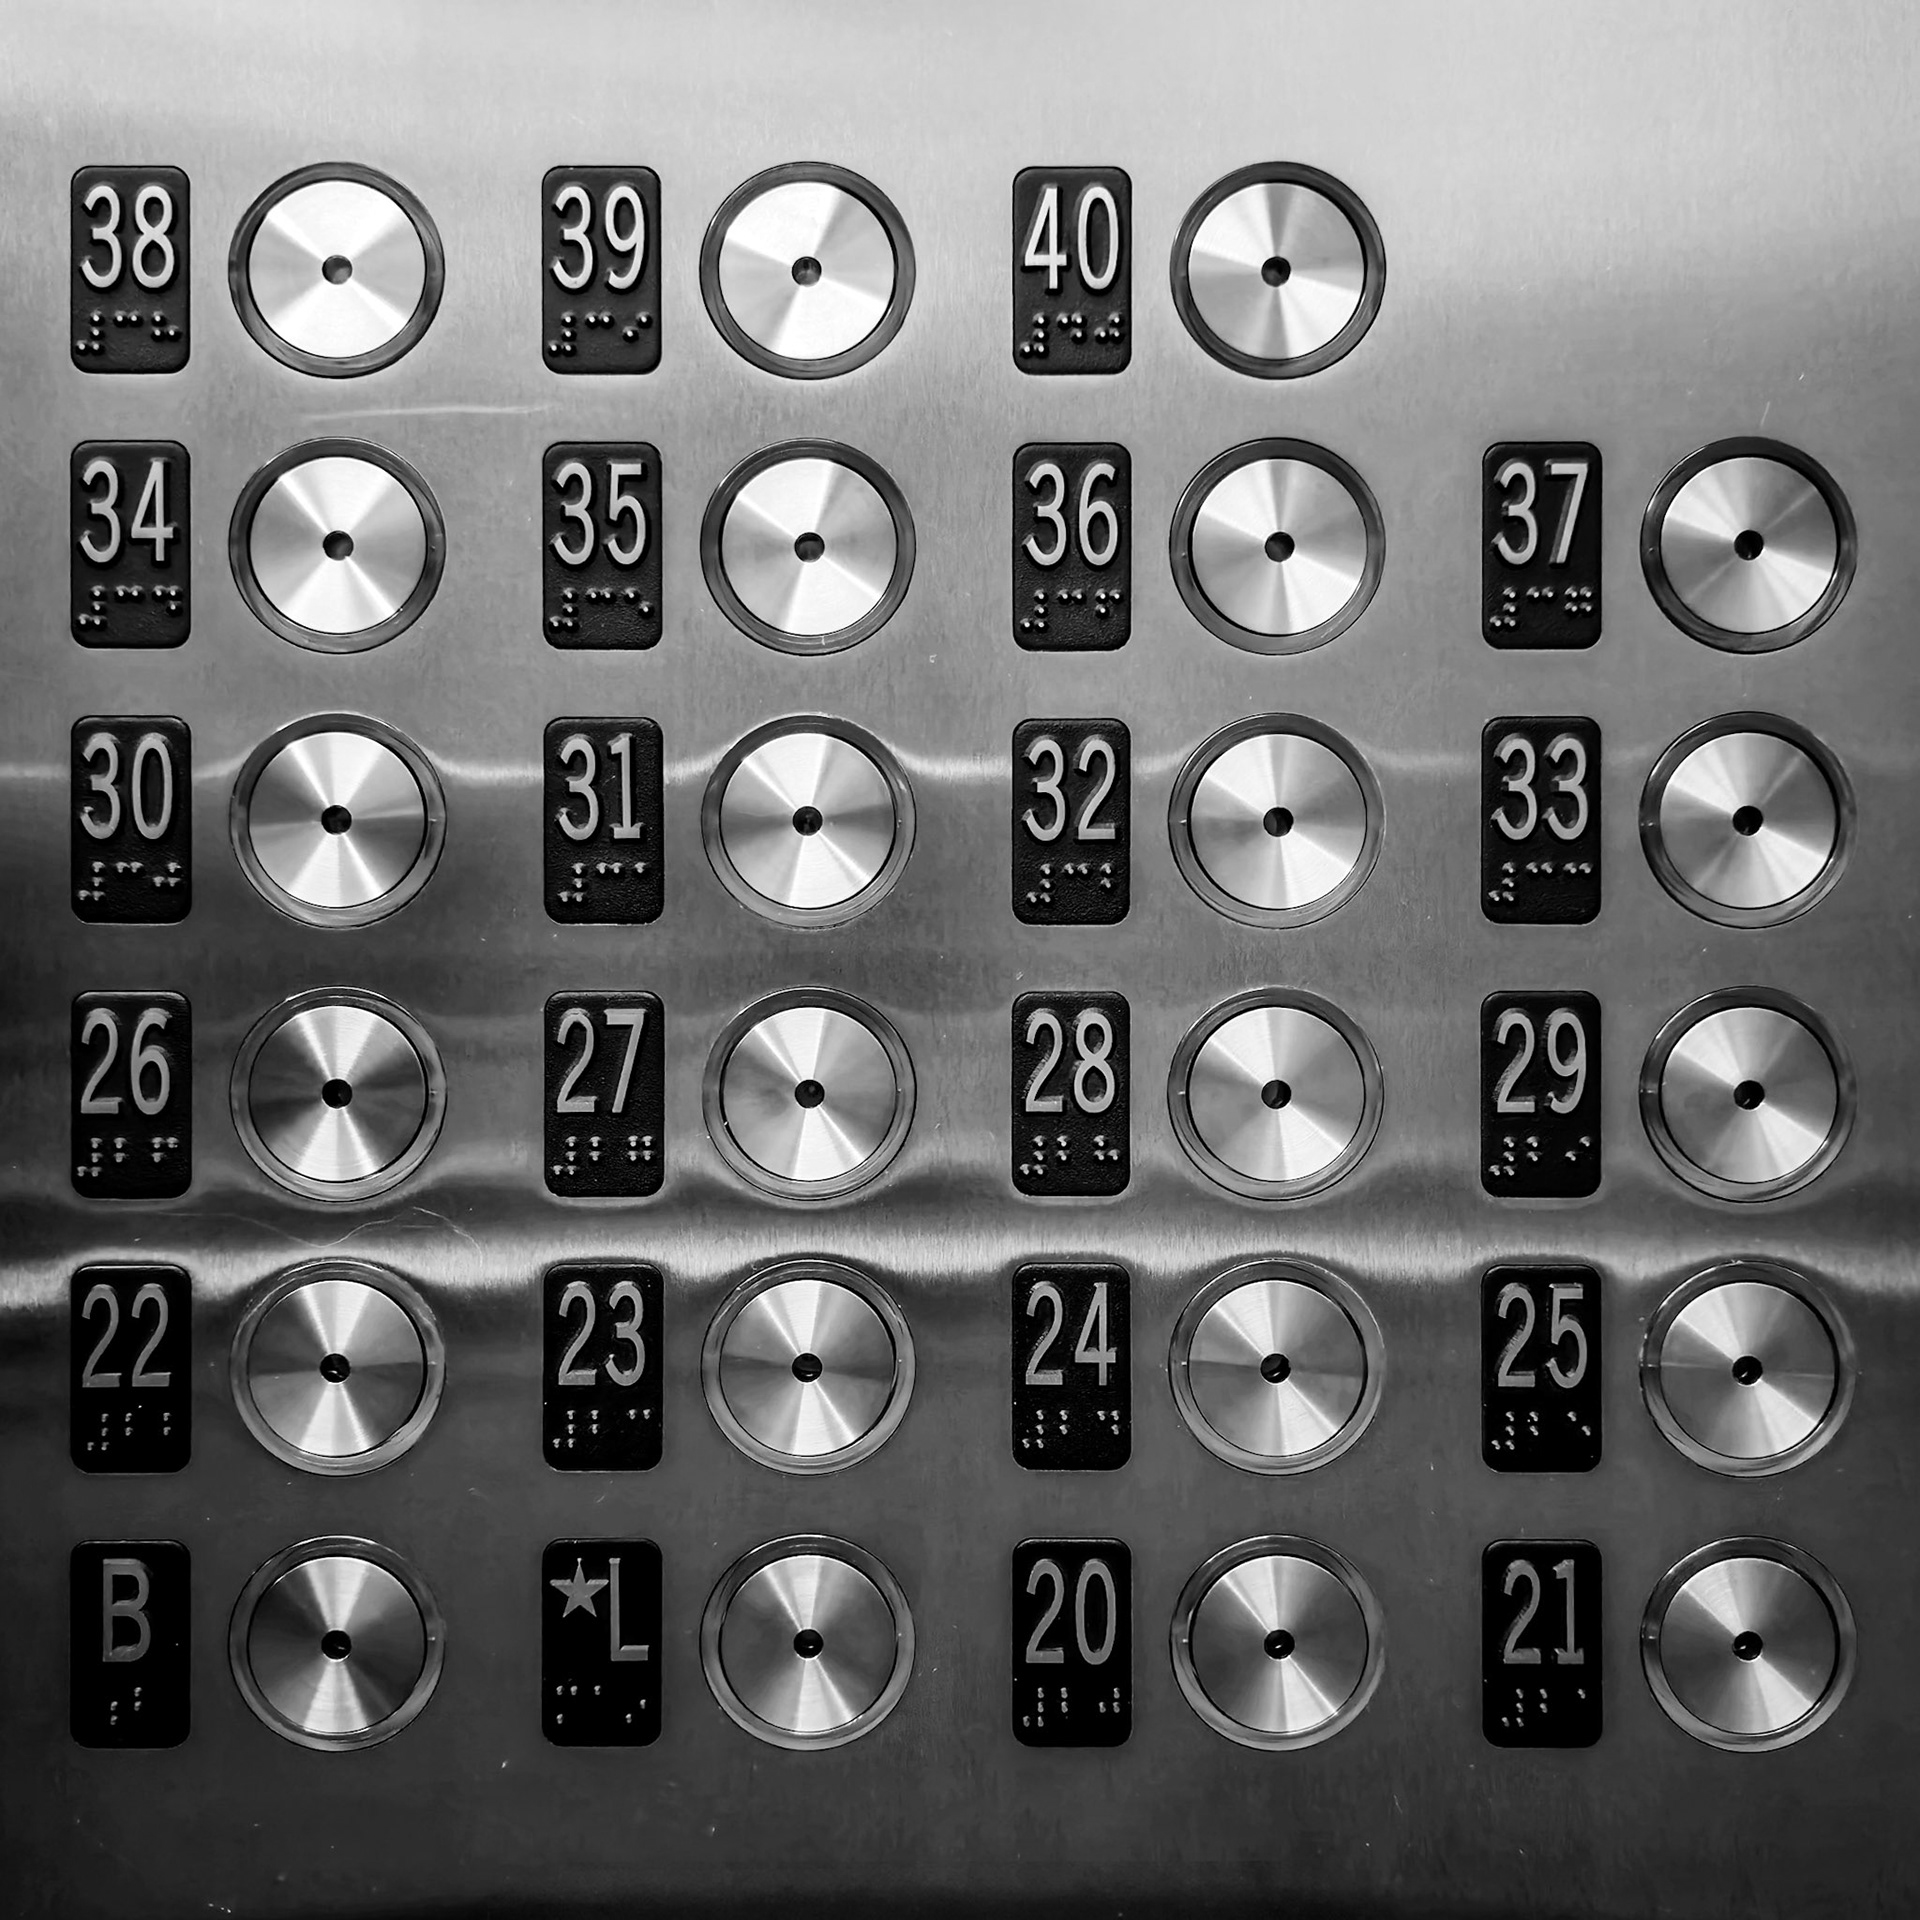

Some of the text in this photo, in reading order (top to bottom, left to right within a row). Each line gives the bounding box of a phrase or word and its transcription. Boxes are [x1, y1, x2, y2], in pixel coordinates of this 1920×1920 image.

[81, 184, 174, 288] 38
[552, 185, 645, 289] 39
[1024, 185, 1118, 289] 40
[80, 457, 174, 562] 34
[551, 460, 646, 565] 35
[1022, 462, 1118, 566] 36
[1491, 460, 1588, 565] 37
[79, 732, 173, 840] 30
[555, 733, 644, 841] 31
[1022, 734, 1116, 841] 32
[1491, 733, 1588, 840] 33
[80, 1008, 172, 1114] 26
[556, 1008, 647, 1113] 27
[1025, 1008, 1116, 1113] 28
[1495, 1008, 1587, 1113] 29
[81, 1283, 172, 1388] 22
[557, 1281, 646, 1387] 23
[1025, 1281, 1117, 1386] 24
[1496, 1283, 1588, 1388] 25
[102, 1558, 151, 1662] B
[609, 1558, 649, 1661] L
[1025, 1559, 1117, 1665] 20
[1502, 1559, 1585, 1665] 21
